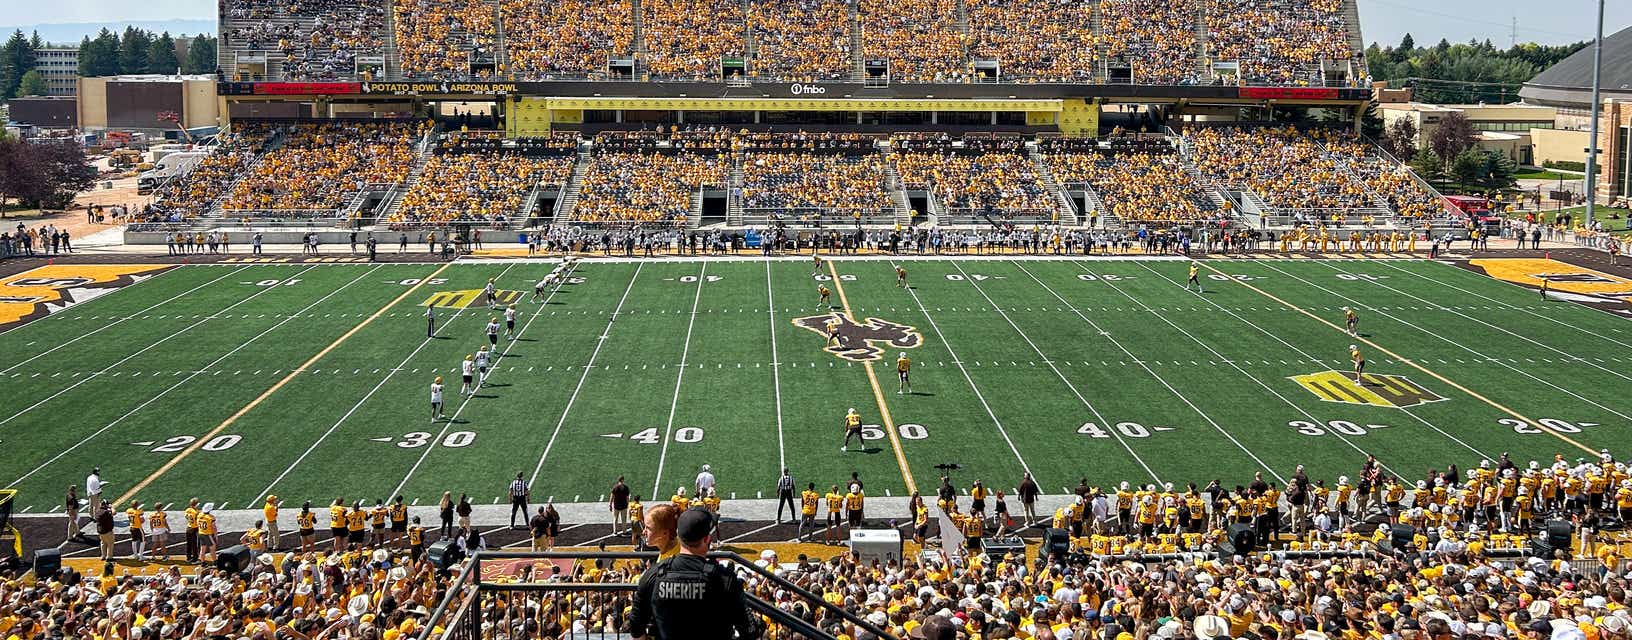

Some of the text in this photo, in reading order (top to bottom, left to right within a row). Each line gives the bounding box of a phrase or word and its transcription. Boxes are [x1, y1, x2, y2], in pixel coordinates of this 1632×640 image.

[803, 84, 826, 94] fnbo
[862, 423, 929, 440] 50
[1077, 421, 1152, 439] 40
[1288, 420, 1367, 436] 30
[1498, 417, 1583, 434] 20
[151, 435, 243, 452] 20
[397, 431, 477, 448] 30
[630, 427, 704, 443] 40
[659, 581, 706, 600] SHERIFF
